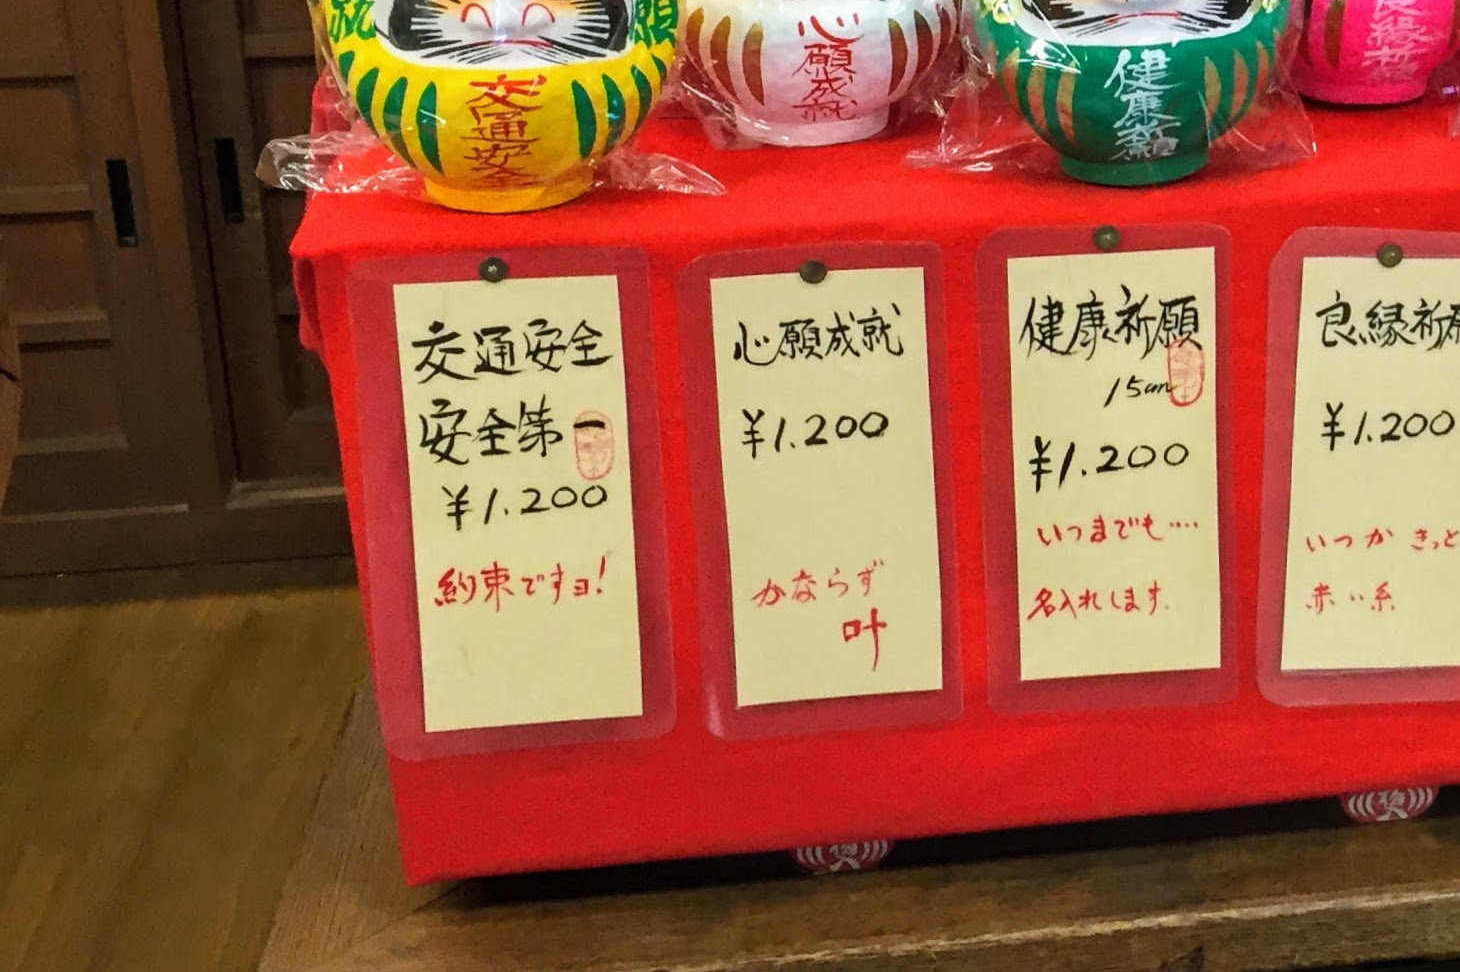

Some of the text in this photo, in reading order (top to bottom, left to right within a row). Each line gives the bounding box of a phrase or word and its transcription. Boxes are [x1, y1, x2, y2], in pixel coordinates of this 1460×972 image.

[411, 319, 614, 385] 交通安全
[733, 302, 904, 366] 心願成就
[1019, 284, 1203, 361] 健康祈願
[418, 394, 606, 467] 安全第一
[751, 560, 885, 608] かならず
